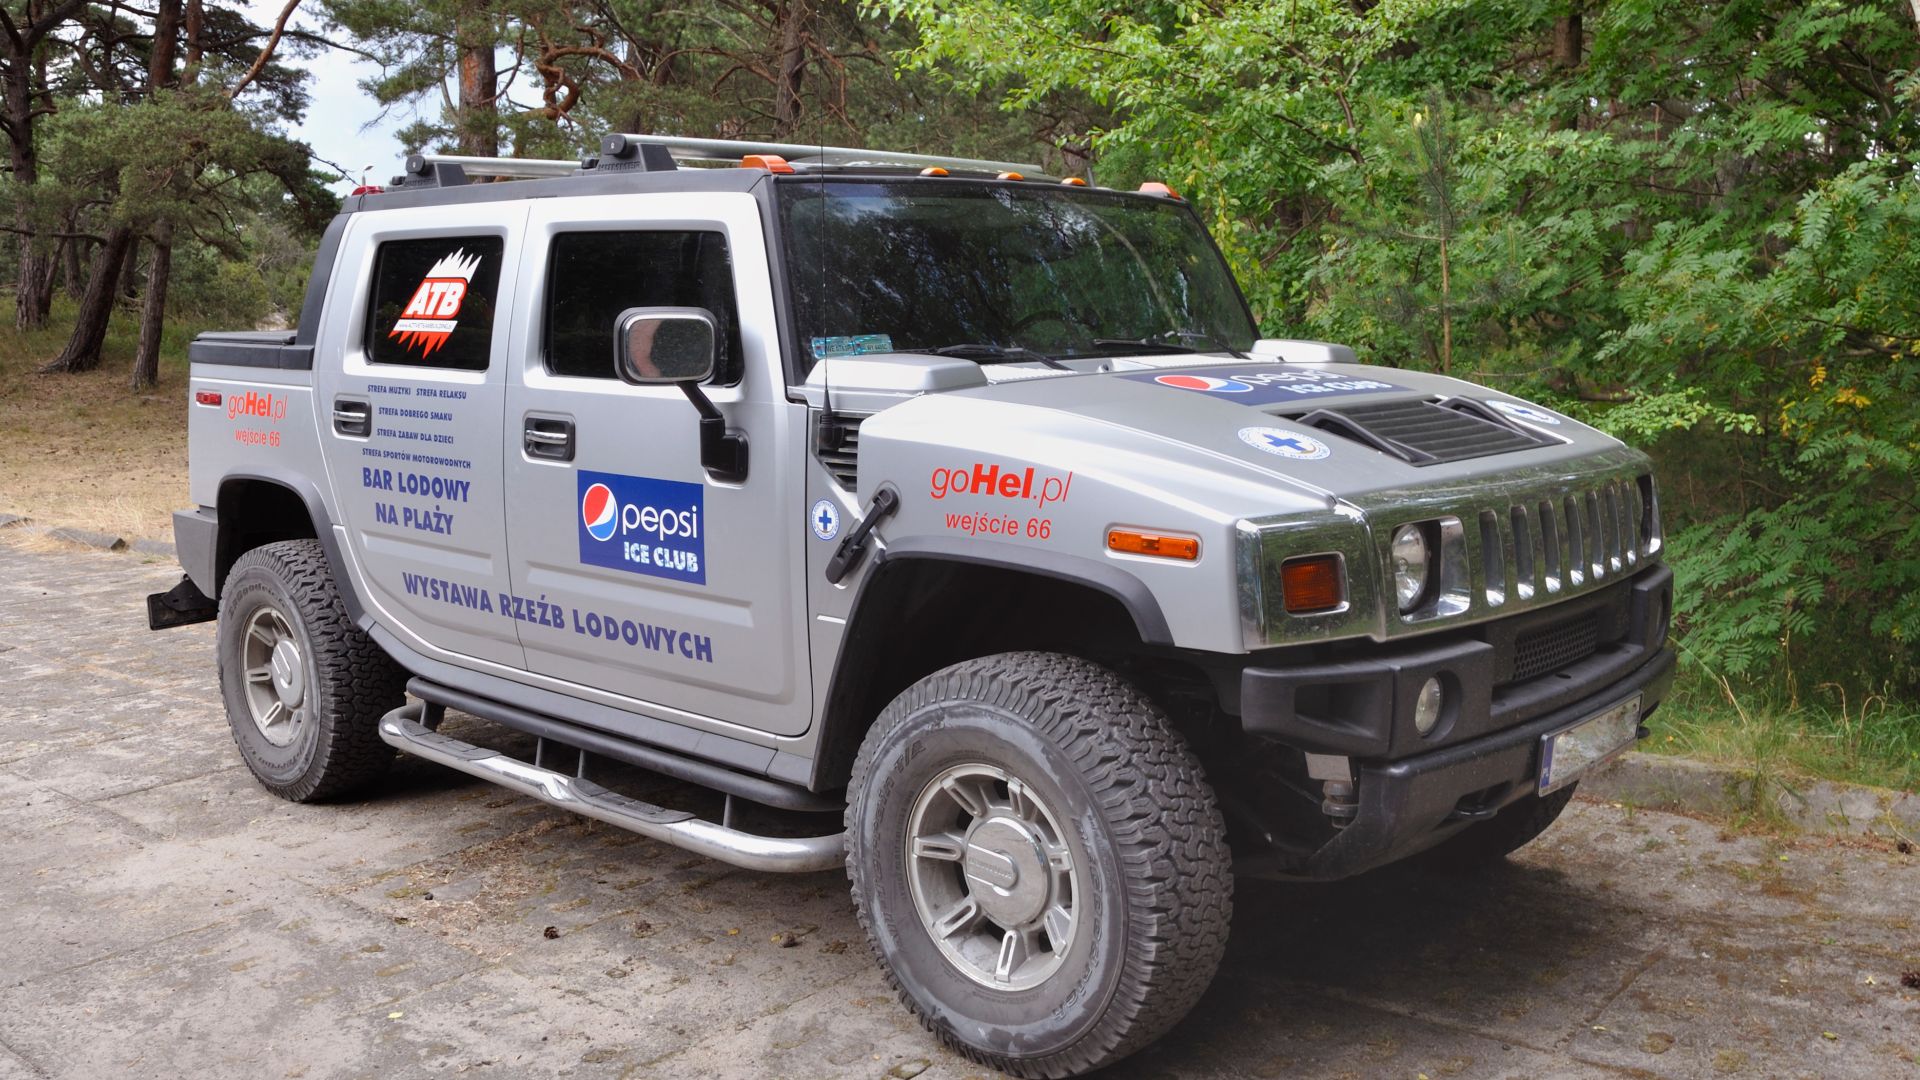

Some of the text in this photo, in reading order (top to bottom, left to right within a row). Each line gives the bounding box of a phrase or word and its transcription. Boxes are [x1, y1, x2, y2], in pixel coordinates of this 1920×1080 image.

[405, 282, 465, 316] ATB
[367, 384, 411, 396] STREFA MUZYKI
[416, 388, 467, 400] STREFA RELAKSU
[227, 391, 288, 425] goHel.pl
[378, 407, 453, 421] STREFA DOBREGO SMAKU
[269, 431, 281, 447] 66
[377, 428, 454, 445] STREFA ZABAW DLA DZIECI
[362, 447, 471, 469] STREFA SPORTÓW MOTOROWODNYCH
[363, 467, 470, 502] BAR LODOWY
[930, 463, 1073, 508] goHel.pl
[375, 502, 454, 535] NA PLAŻY
[622, 503, 698, 541] pepsi
[945, 511, 1051, 539] wejście 66
[624, 541, 698, 573] ICE CLUB
[402, 572, 713, 663] WYSTAWA RZEŹB LODOWYCH
